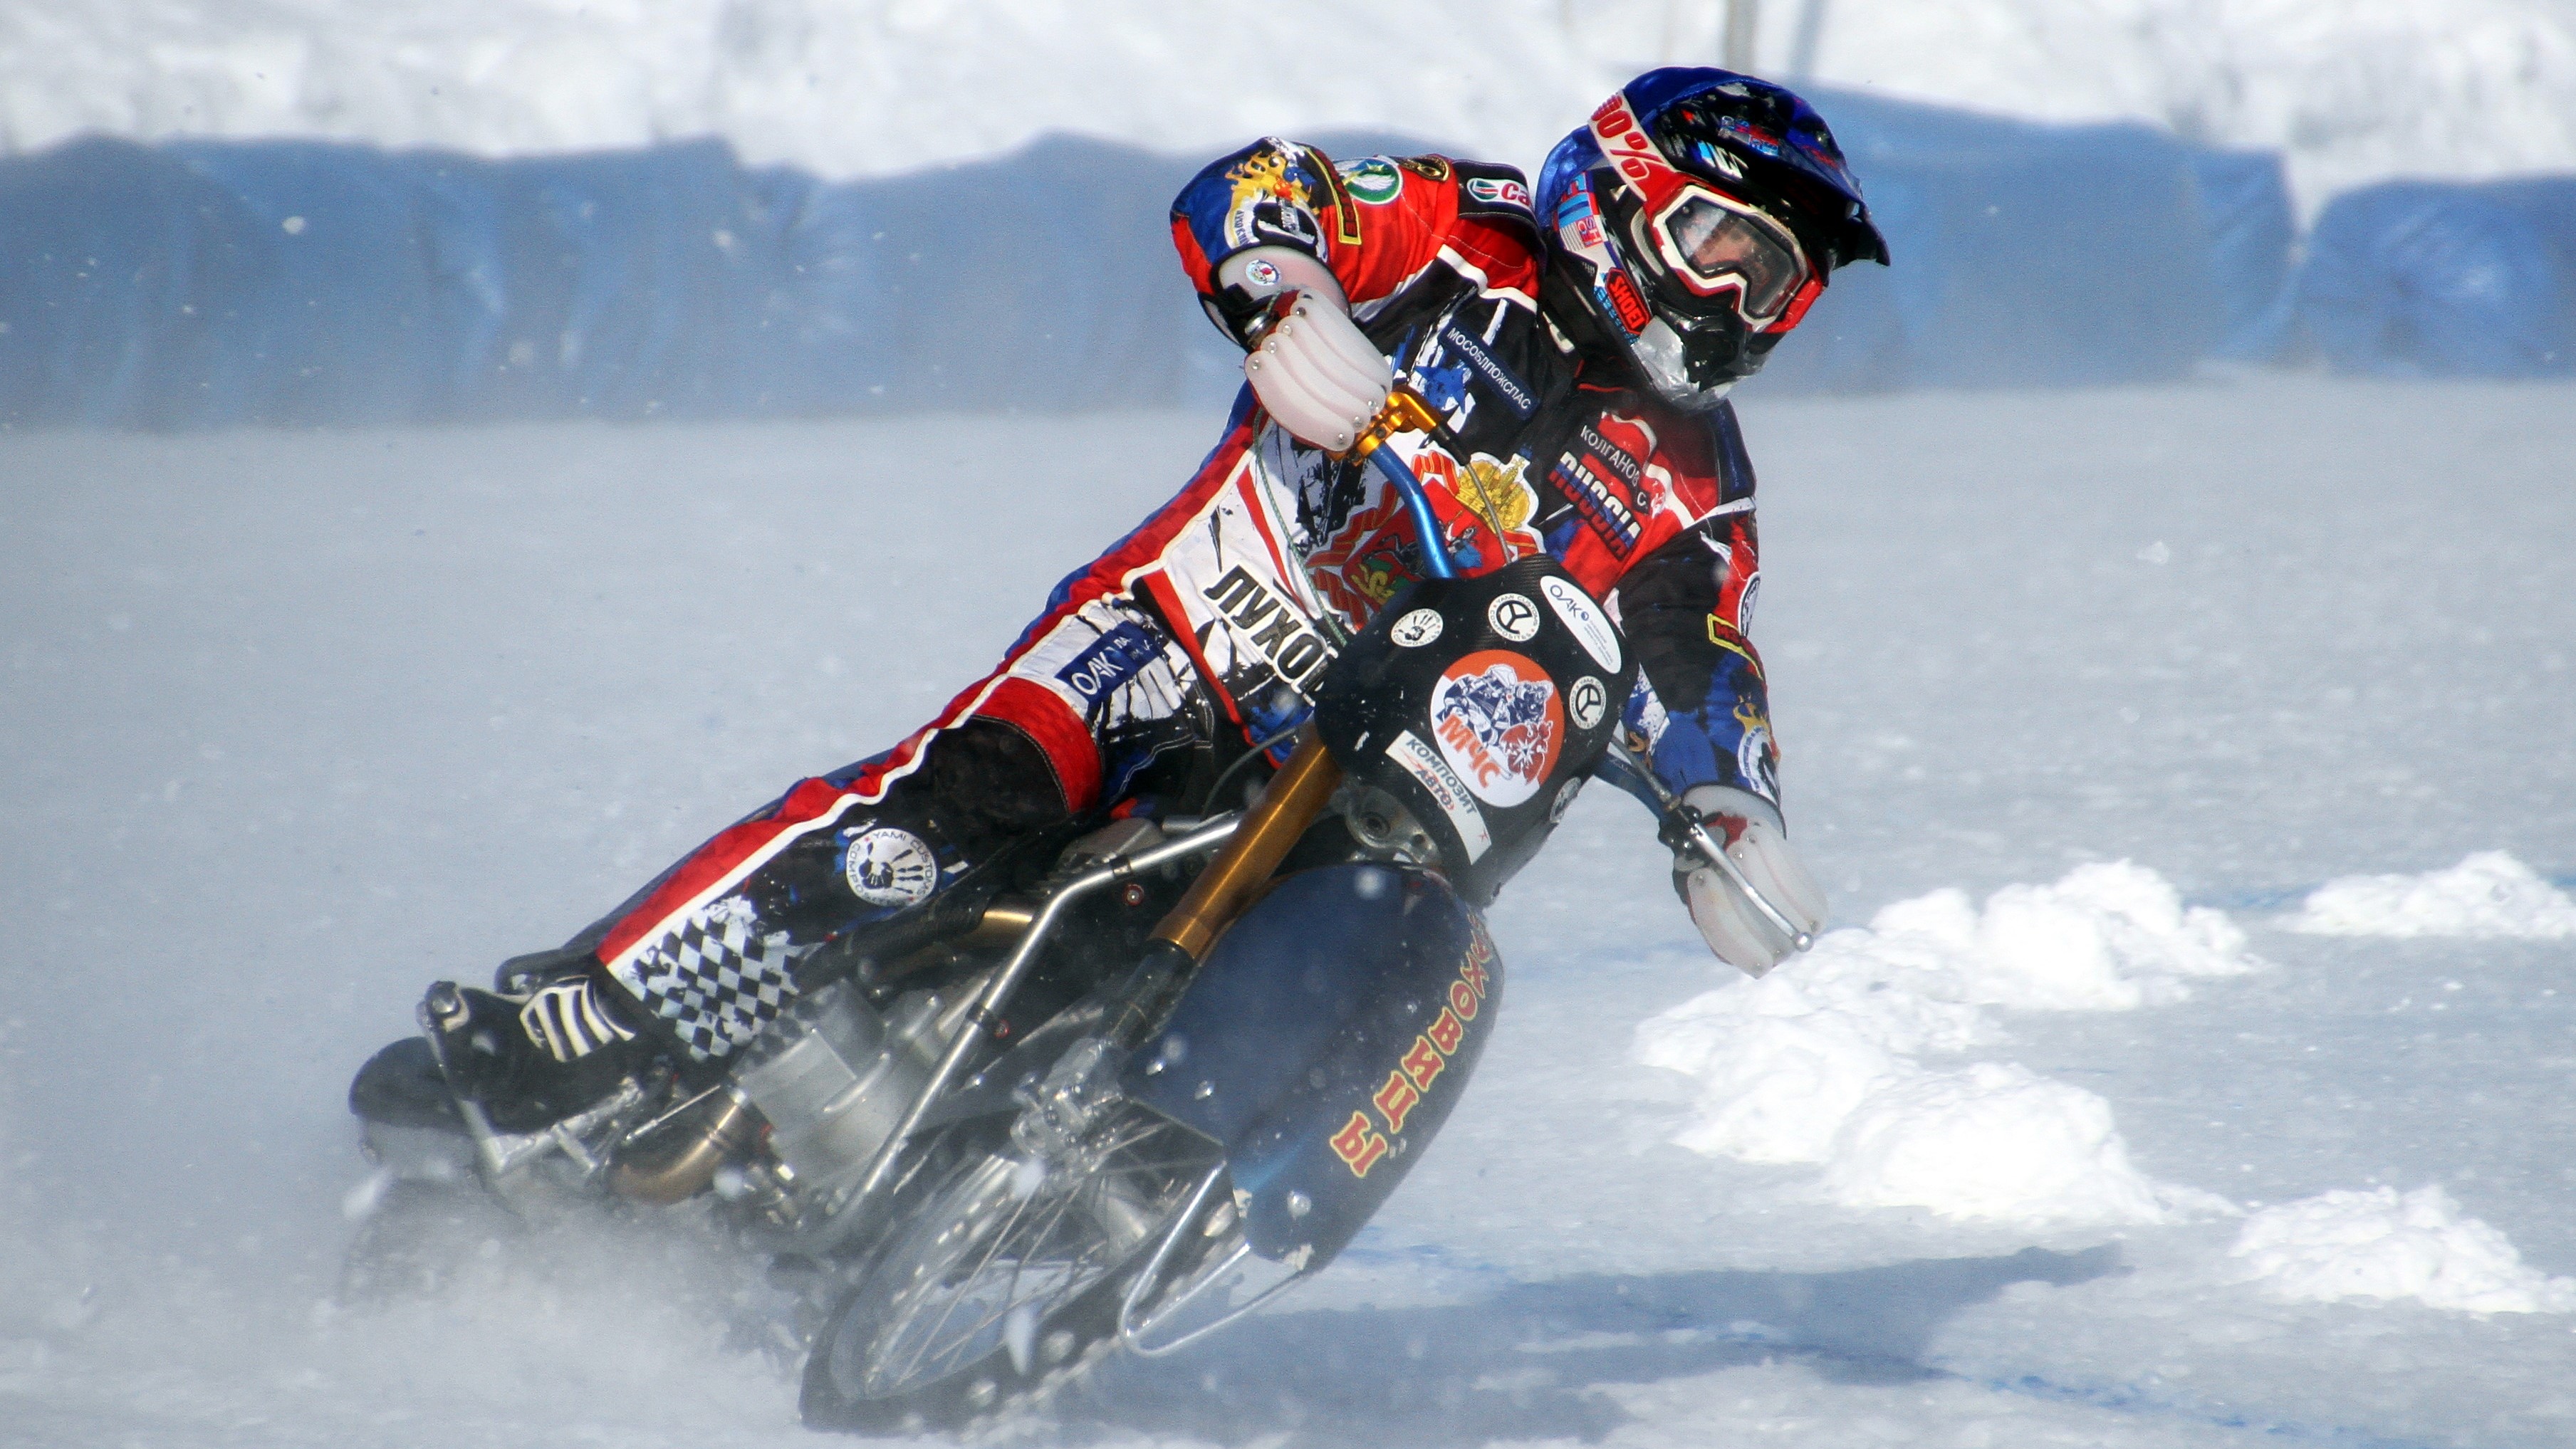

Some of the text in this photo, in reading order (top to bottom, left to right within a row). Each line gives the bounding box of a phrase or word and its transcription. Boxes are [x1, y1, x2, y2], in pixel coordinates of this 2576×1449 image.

[1613, 275, 1644, 333] SHOEI
[1446, 326, 1531, 410] МОСОБЛПОЖСПАС
[1548, 451, 1642, 559] RUSSIA
[1406, 738, 1479, 815] КОМПОЗИТ
[1415, 768, 1451, 809] АВТО
[1439, 716, 1501, 789] МЧС
[872, 831, 934, 895] YAMI CUSTOMS
